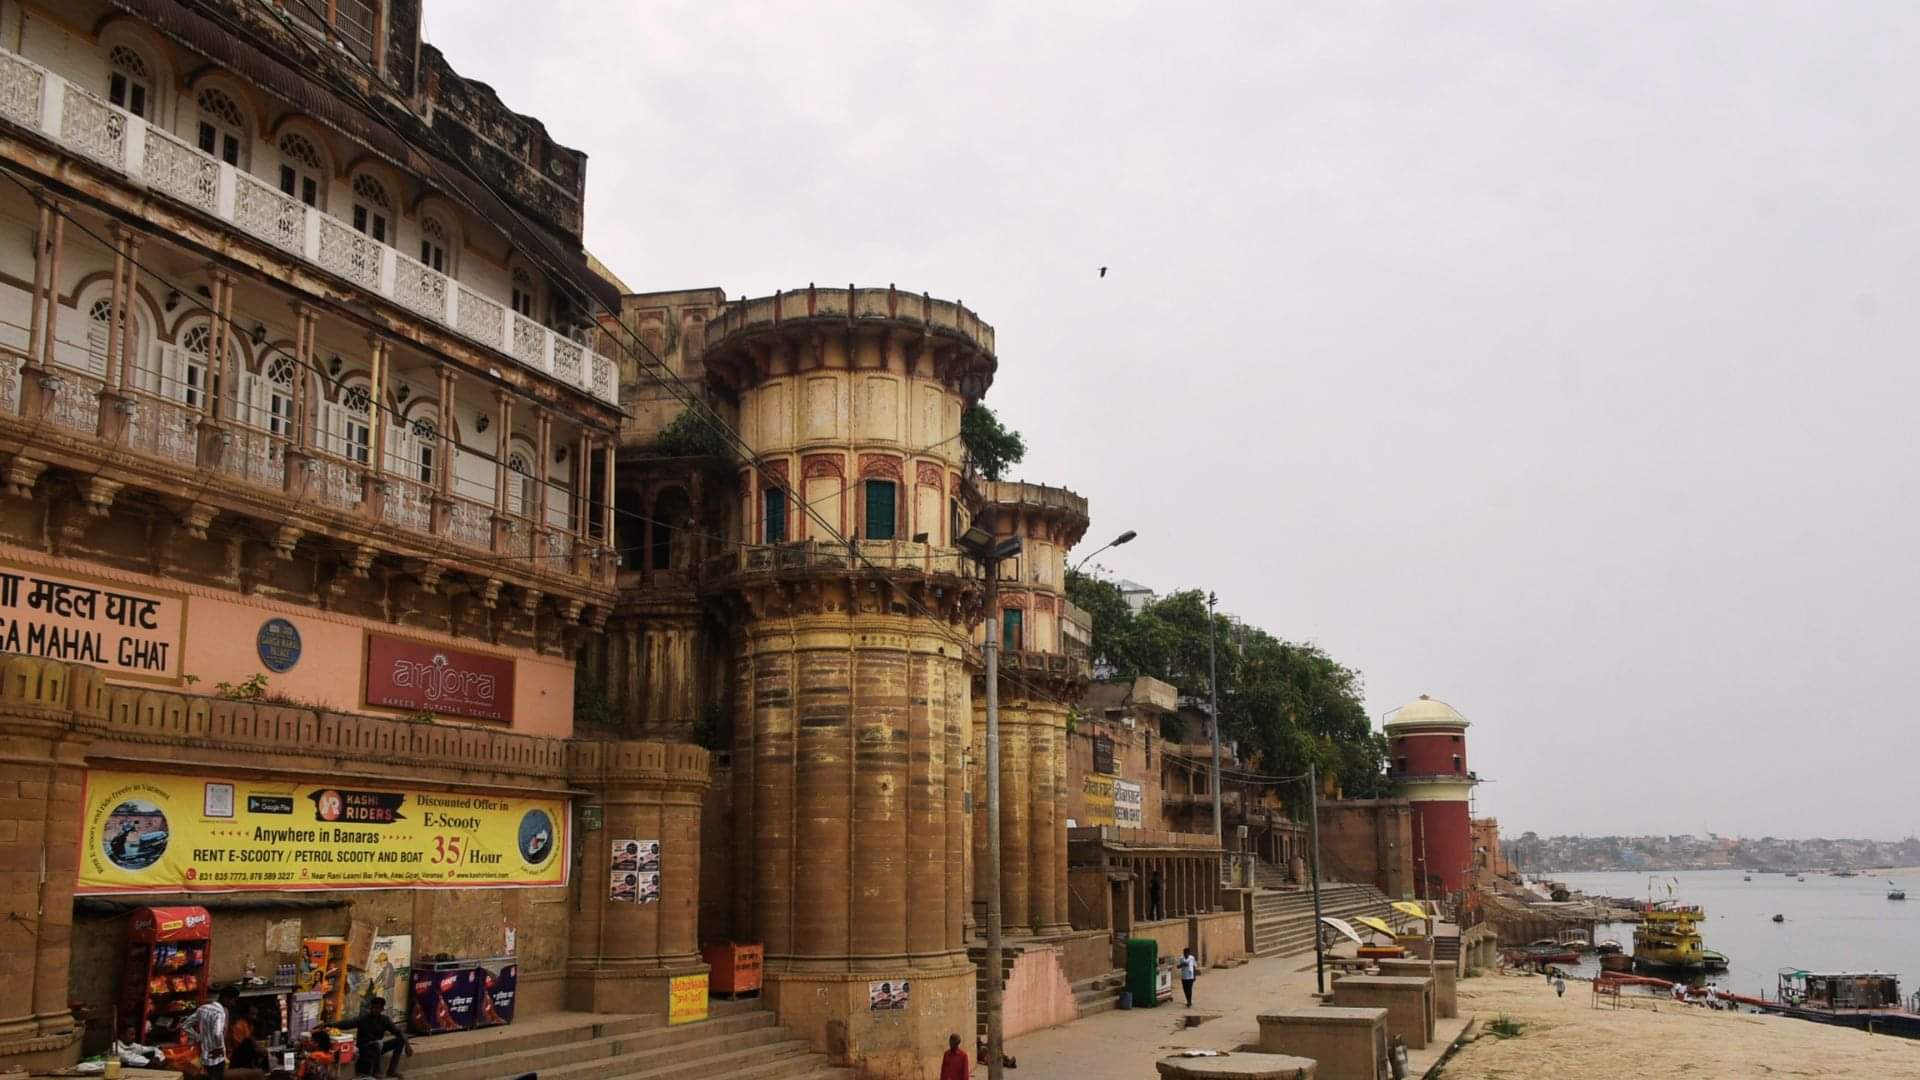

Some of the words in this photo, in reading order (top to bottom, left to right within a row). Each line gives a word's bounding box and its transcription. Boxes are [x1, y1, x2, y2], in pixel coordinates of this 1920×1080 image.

[28, 578, 101, 620] महल
[104, 592, 161, 629] घाट
[28, 622, 108, 663] MAHAL
[118, 637, 169, 671] GHAT
[392, 655, 495, 700] anjora
[347, 795, 379, 806] KASHI
[417, 795, 471, 809] Discounted
[473, 799, 496, 811] Offer
[499, 801, 509, 811] in
[346, 807, 392, 820] RIDERS
[424, 812, 481, 832] E-Scooty
[254, 826, 315, 845] Anywhere
[319, 829, 329, 842] in
[334, 829, 380, 844] Banaras
[193, 849, 224, 862] RENT
[229, 849, 284, 863] E-SCOOTY
[295, 851, 332, 863] PETROL
[337, 851, 374, 863] SCOOTY
[378, 852, 398, 863] AND
[400, 852, 424, 863] BOAT
[470, 850, 502, 863] Hour
